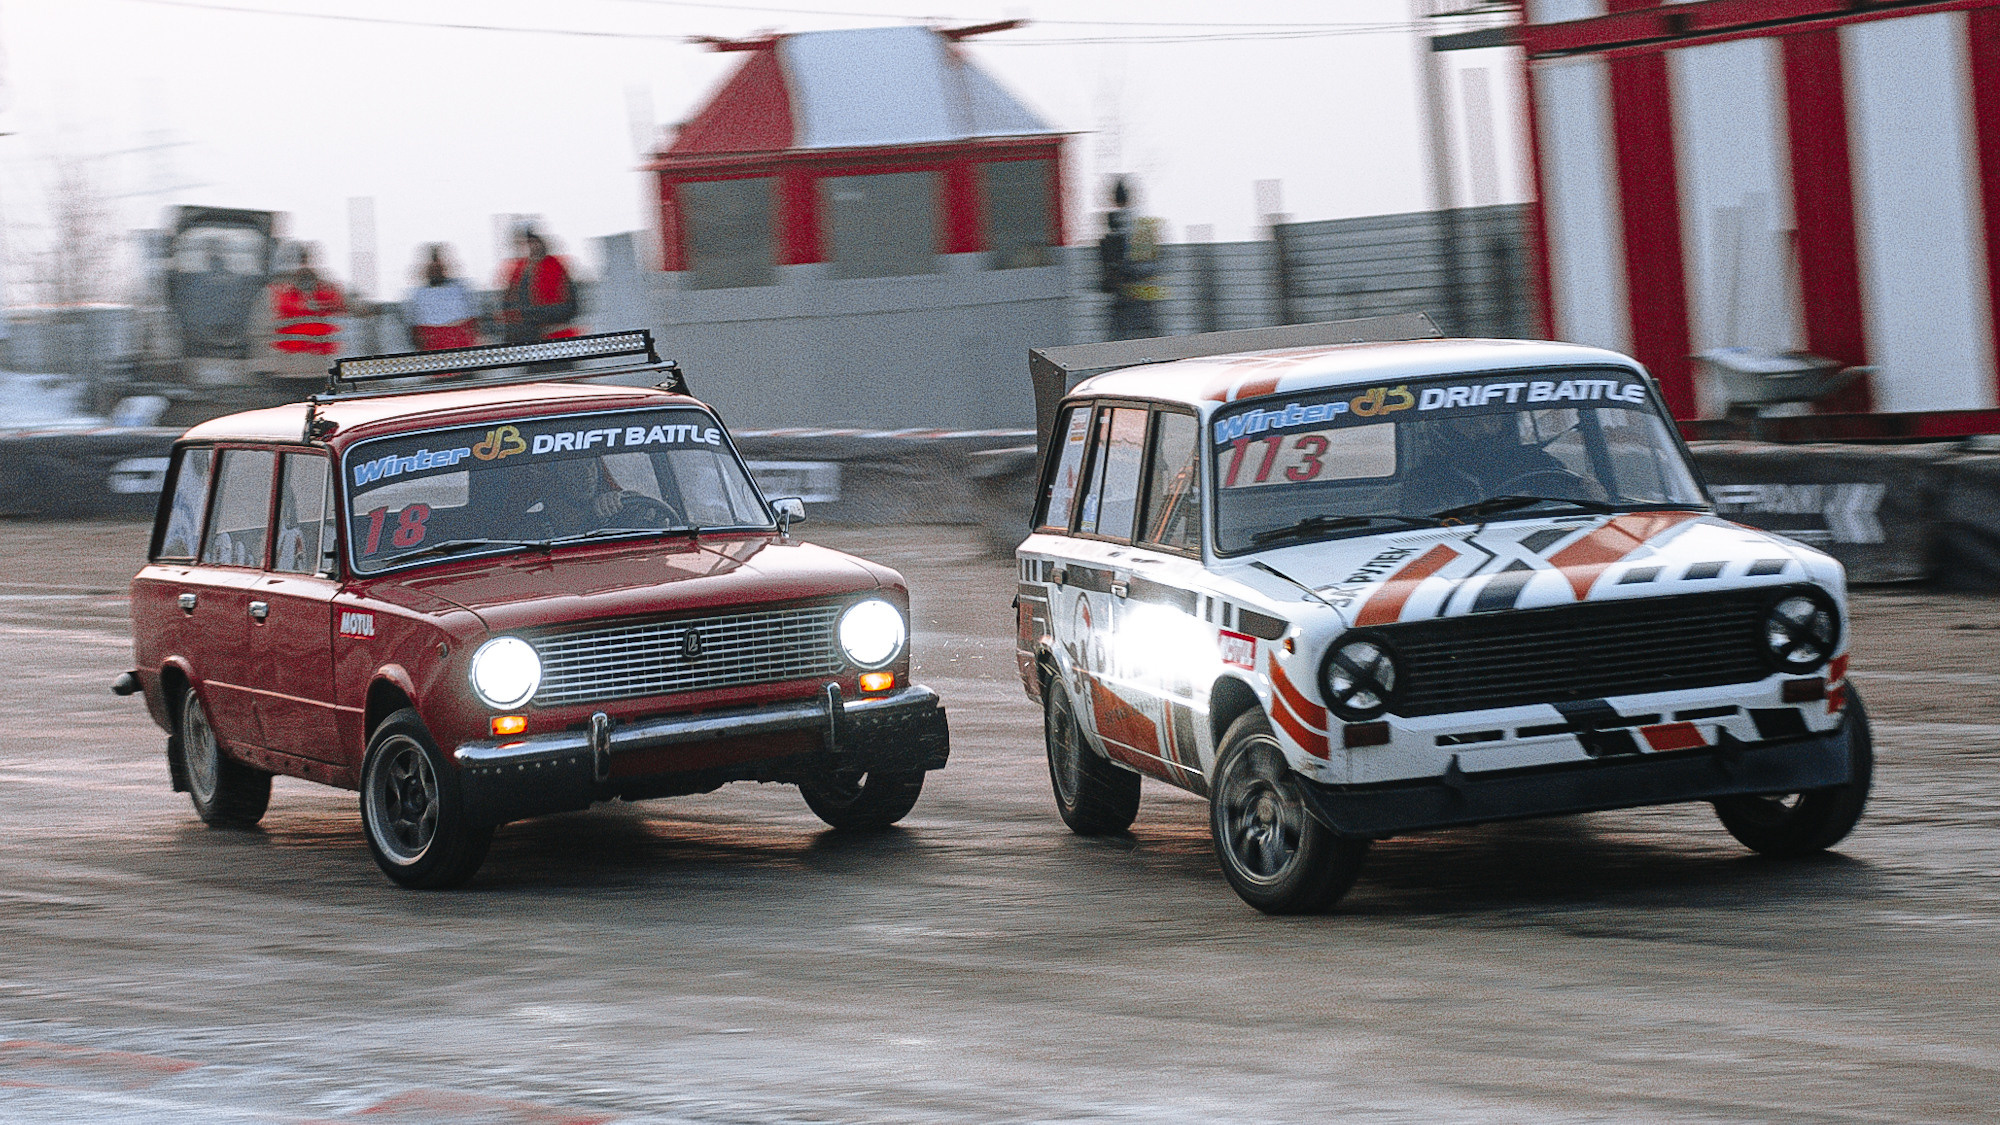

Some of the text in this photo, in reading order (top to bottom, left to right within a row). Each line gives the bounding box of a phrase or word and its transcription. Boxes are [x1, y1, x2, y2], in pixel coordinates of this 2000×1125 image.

[1214, 401, 1350, 445] Winter
[1417, 381, 1528, 411] DRIFT
[1527, 379, 1647, 404] BATTLE
[354, 447, 470, 487] Winter
[531, 428, 622, 455] DRIFT
[624, 424, 721, 447] BATTLE
[1225, 435, 1330, 488] 113
[362, 502, 431, 556] 18
